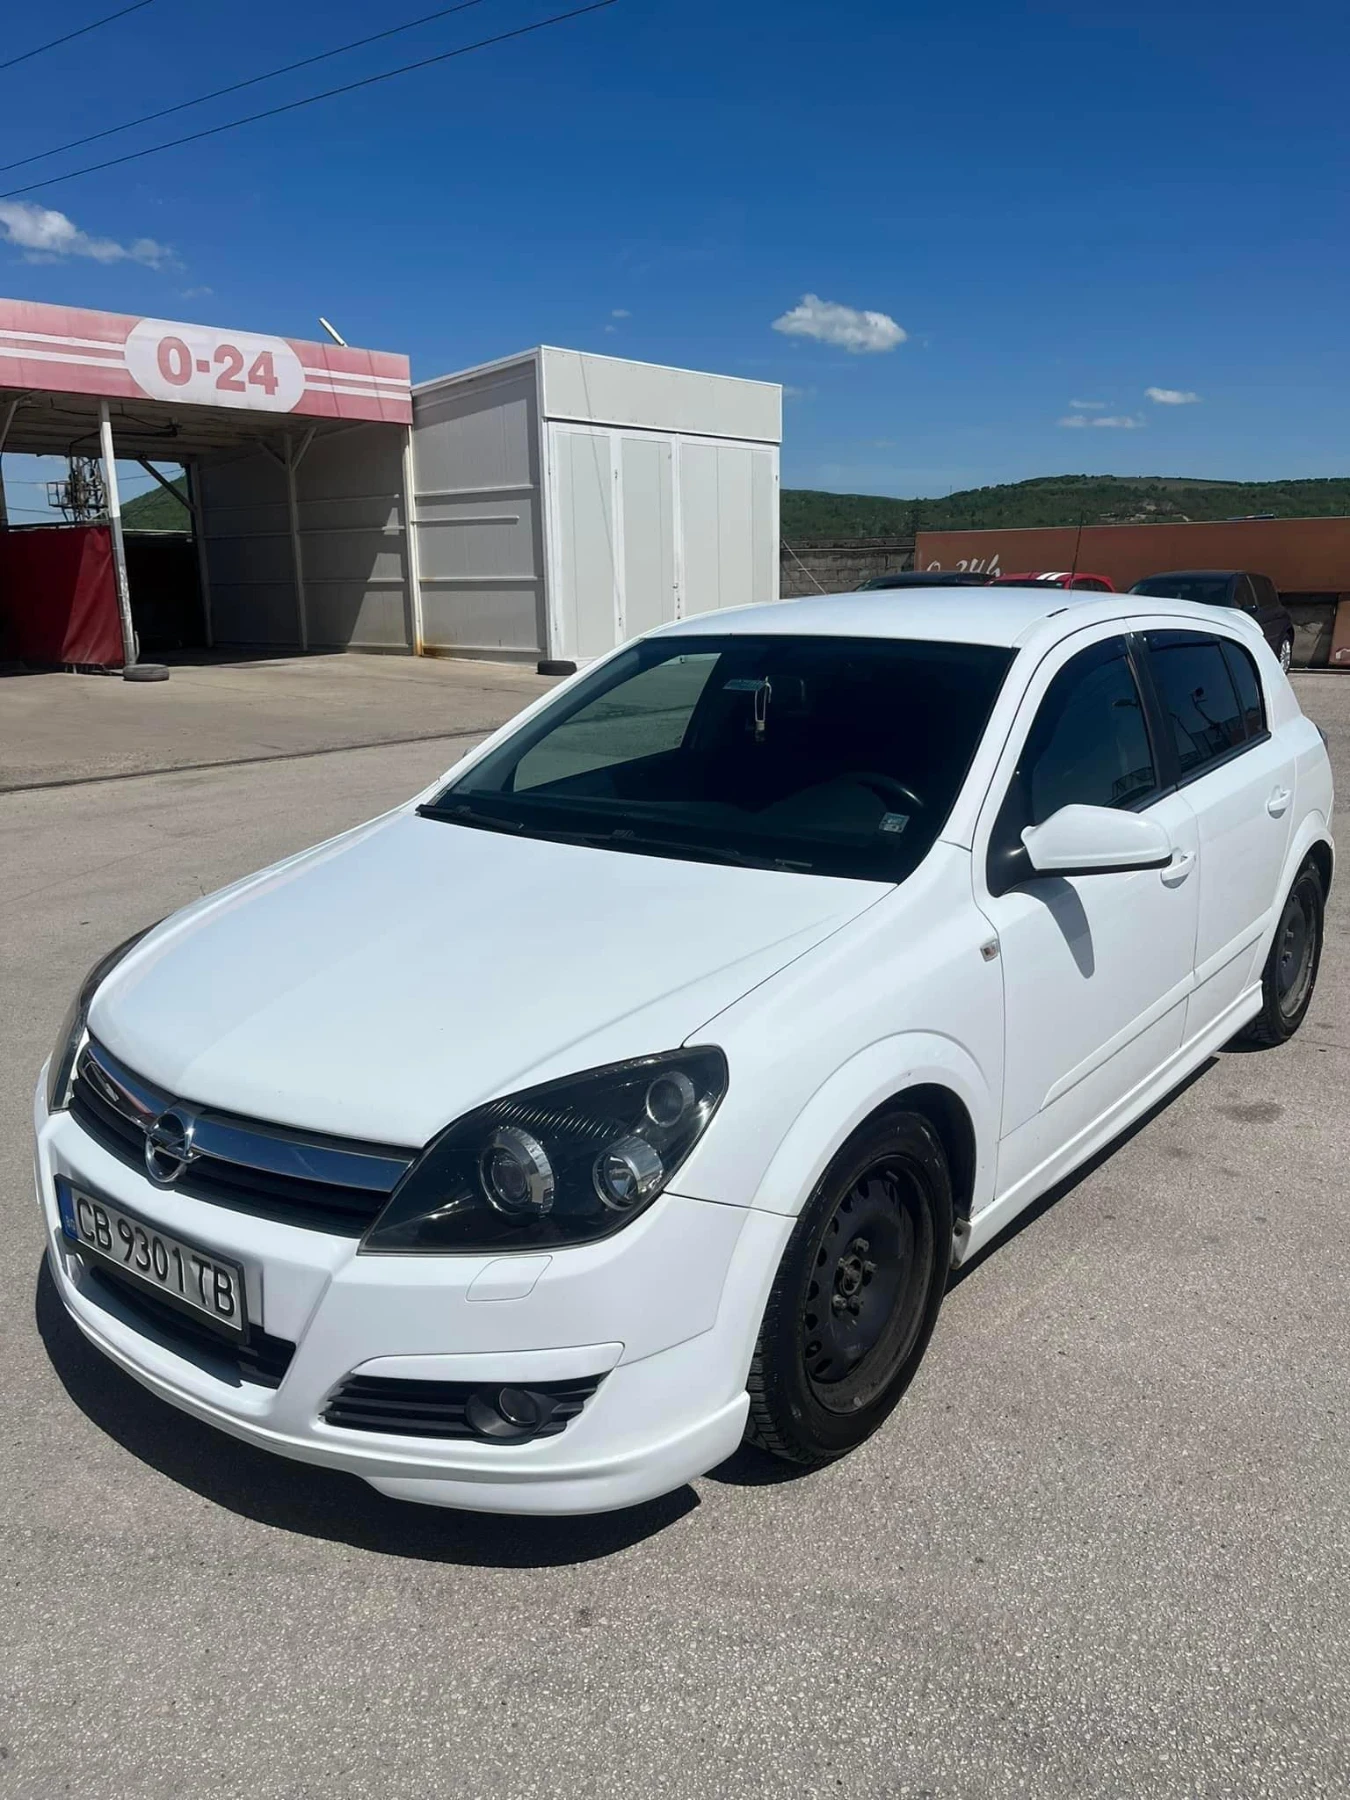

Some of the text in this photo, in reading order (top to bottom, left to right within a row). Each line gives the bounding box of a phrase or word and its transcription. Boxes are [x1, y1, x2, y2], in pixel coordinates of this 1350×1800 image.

[157, 336, 279, 395] 0-24
[77, 1198, 235, 1317] CB 9301 TB
